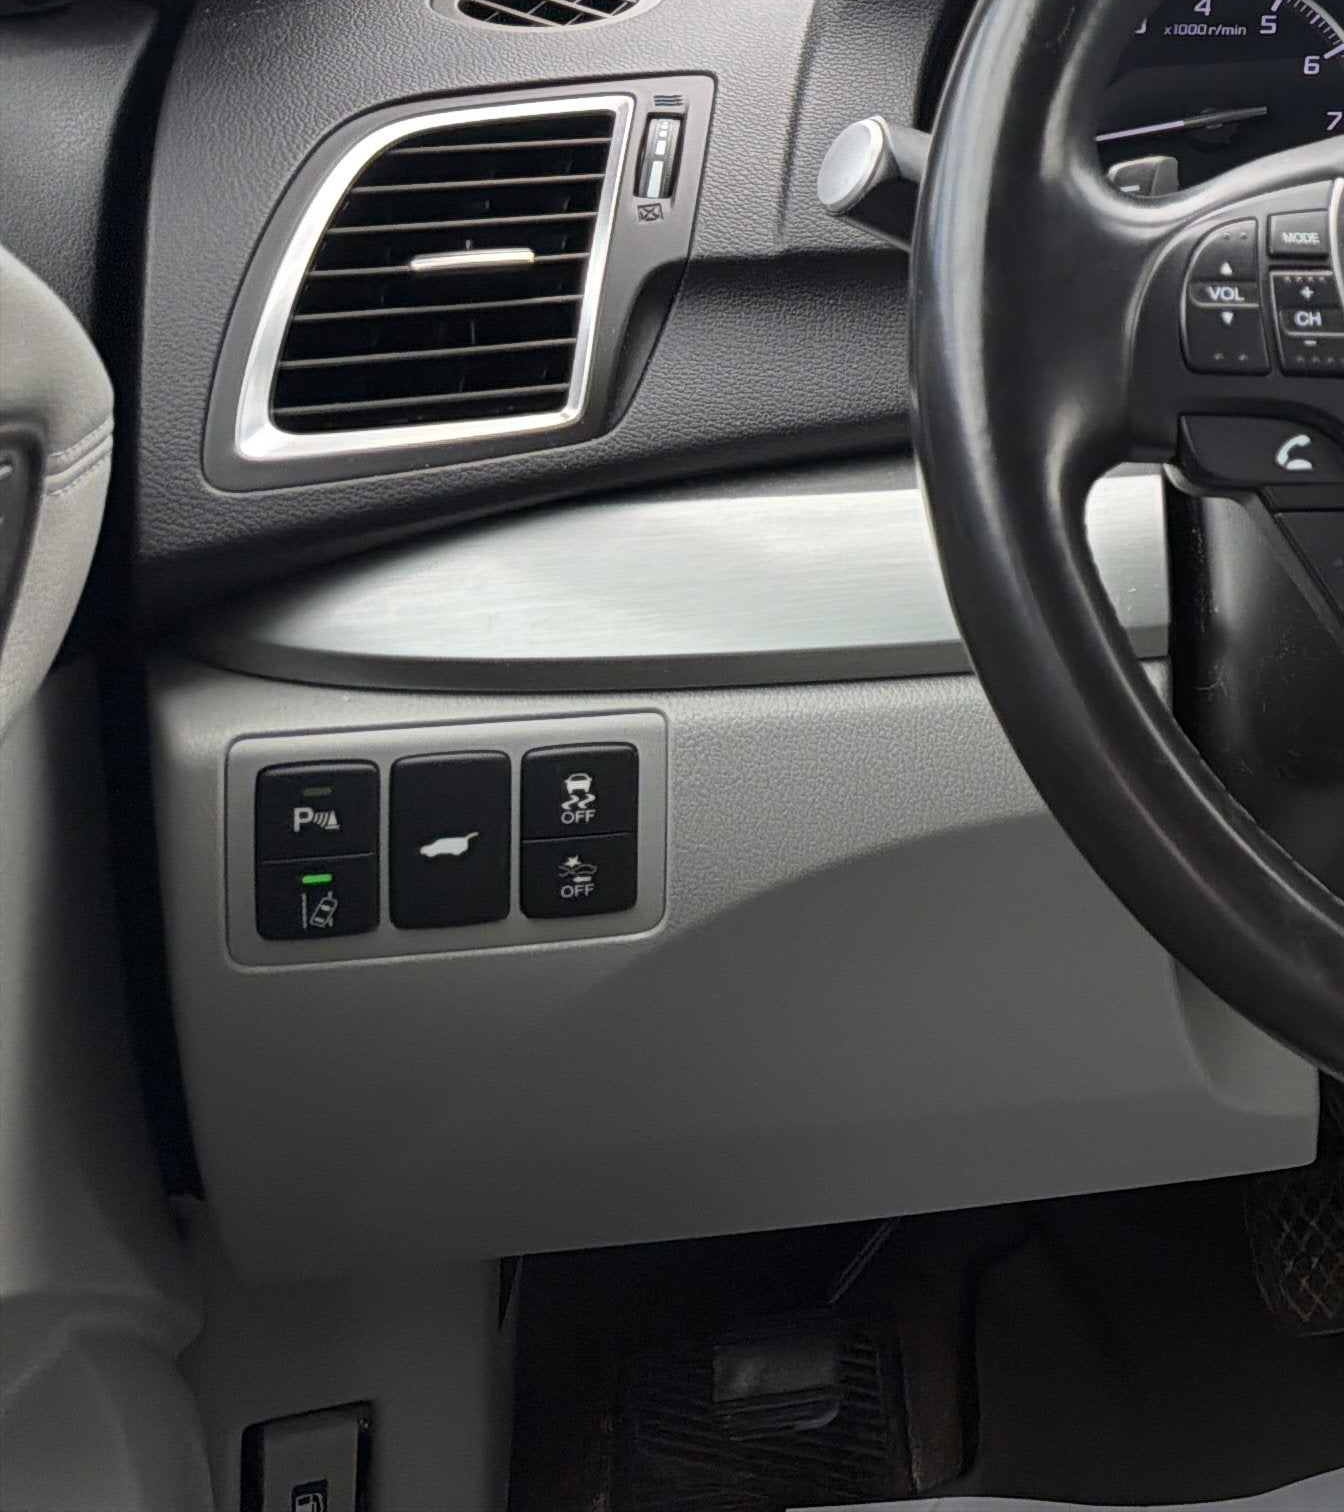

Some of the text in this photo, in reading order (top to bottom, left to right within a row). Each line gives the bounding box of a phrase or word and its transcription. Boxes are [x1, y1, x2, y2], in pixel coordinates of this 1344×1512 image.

[1259, 15, 1277, 35] 5
[1304, 55, 1321, 76] 6
[1326, 111, 1343, 131] 7
[1282, 232, 1321, 244] MODE
[1207, 286, 1245, 302] VOL
[1294, 311, 1323, 326] CH
[561, 808, 596, 825] OFF
[560, 884, 595, 899] OFF
